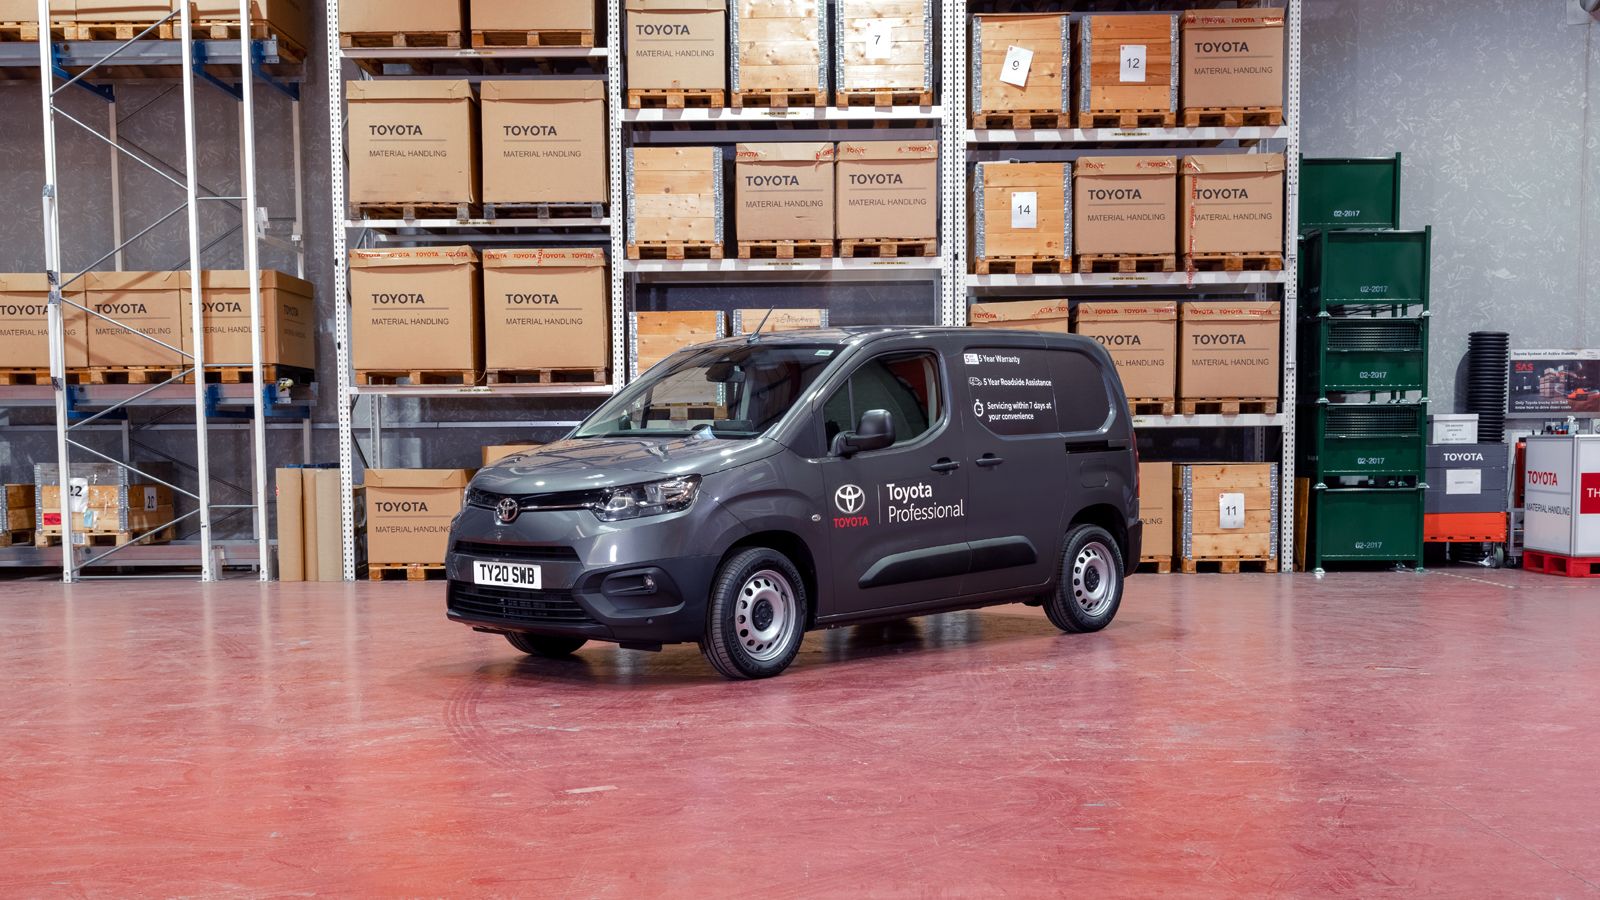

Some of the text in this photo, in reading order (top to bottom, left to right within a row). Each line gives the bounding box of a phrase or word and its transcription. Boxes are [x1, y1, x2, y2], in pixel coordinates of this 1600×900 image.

[636, 24, 690, 35] TOYOTA
[874, 35, 881, 45] 7
[1194, 42, 1249, 52] TOYOTA
[636, 49, 714, 57] MATERIAL HANDLING
[1012, 60, 1020, 71] 9
[1127, 58, 1140, 68] 12
[1194, 66, 1273, 75] MATERIAL HANDLING
[369, 125, 423, 136] TOYOTA
[503, 125, 557, 136] TOYOTA
[503, 150, 581, 158] MATERIAL HANDLING
[745, 175, 800, 186] TOYOTA
[849, 173, 903, 184] TOYOTA
[1088, 189, 1142, 200] TOYOTA
[1194, 188, 1248, 199] TOYOTA
[887, 198, 927, 206] HANDLING
[1017, 205, 1031, 215] 14
[1126, 213, 1165, 221] HANDLING
[371, 293, 425, 304] TOYOTA
[505, 294, 559, 304] TOYOTA
[94, 303, 147, 314] TOYOTA
[228, 325, 266, 333] HANDLG
[1192, 334, 1246, 345] TOYOTA
[995, 355, 1020, 364] Warranty
[1230, 358, 1269, 366] HANDLING
[1515, 363, 1534, 371] SAS
[983, 378, 1052, 386] 5 Year Roadside Assistance
[987, 402, 1012, 411] Servicing
[1012, 401, 1029, 409] within
[1033, 402, 1045, 411] days
[988, 412, 1034, 422] your convenience
[1443, 453, 1484, 461] TOYOTA
[1527, 470, 1558, 486] TOYOTA
[886, 482, 933, 504] Toyota
[375, 501, 428, 512] TOYOTA
[888, 499, 964, 523] Professional
[1226, 506, 1237, 516] 11
[1526, 502, 1570, 516] MATERIAL HANDLING
[833, 516, 869, 528] TOYOTA
[480, 564, 535, 584] TY20 SWB
